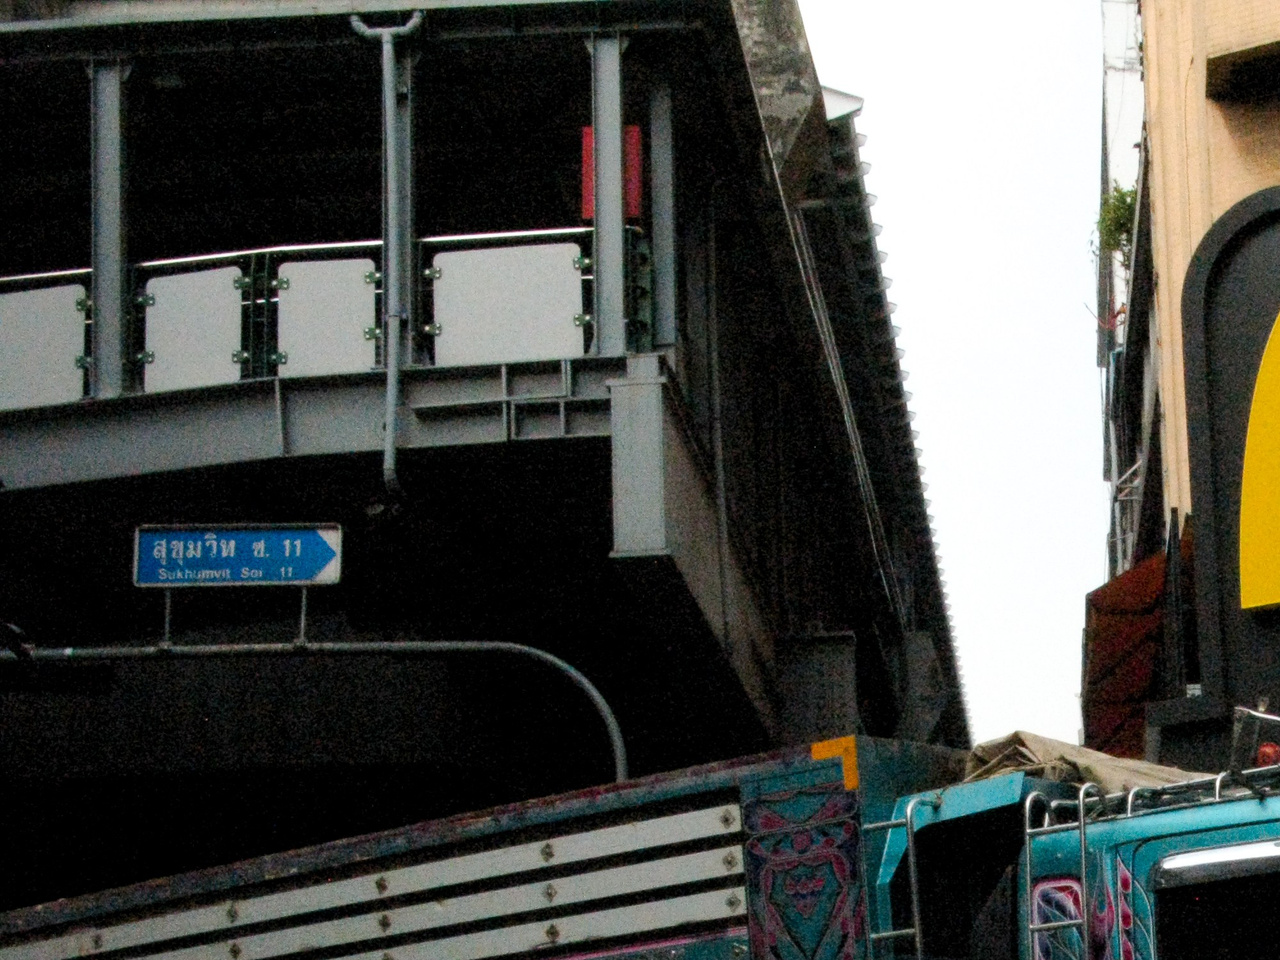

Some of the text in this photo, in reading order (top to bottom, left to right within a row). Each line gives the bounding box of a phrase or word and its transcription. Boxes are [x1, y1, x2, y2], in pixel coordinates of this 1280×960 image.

[153, 533, 235, 566] สุขุมวิท
[282, 539, 302, 557] 11
[158, 566, 293, 580] Sukhumvit Soi 11
